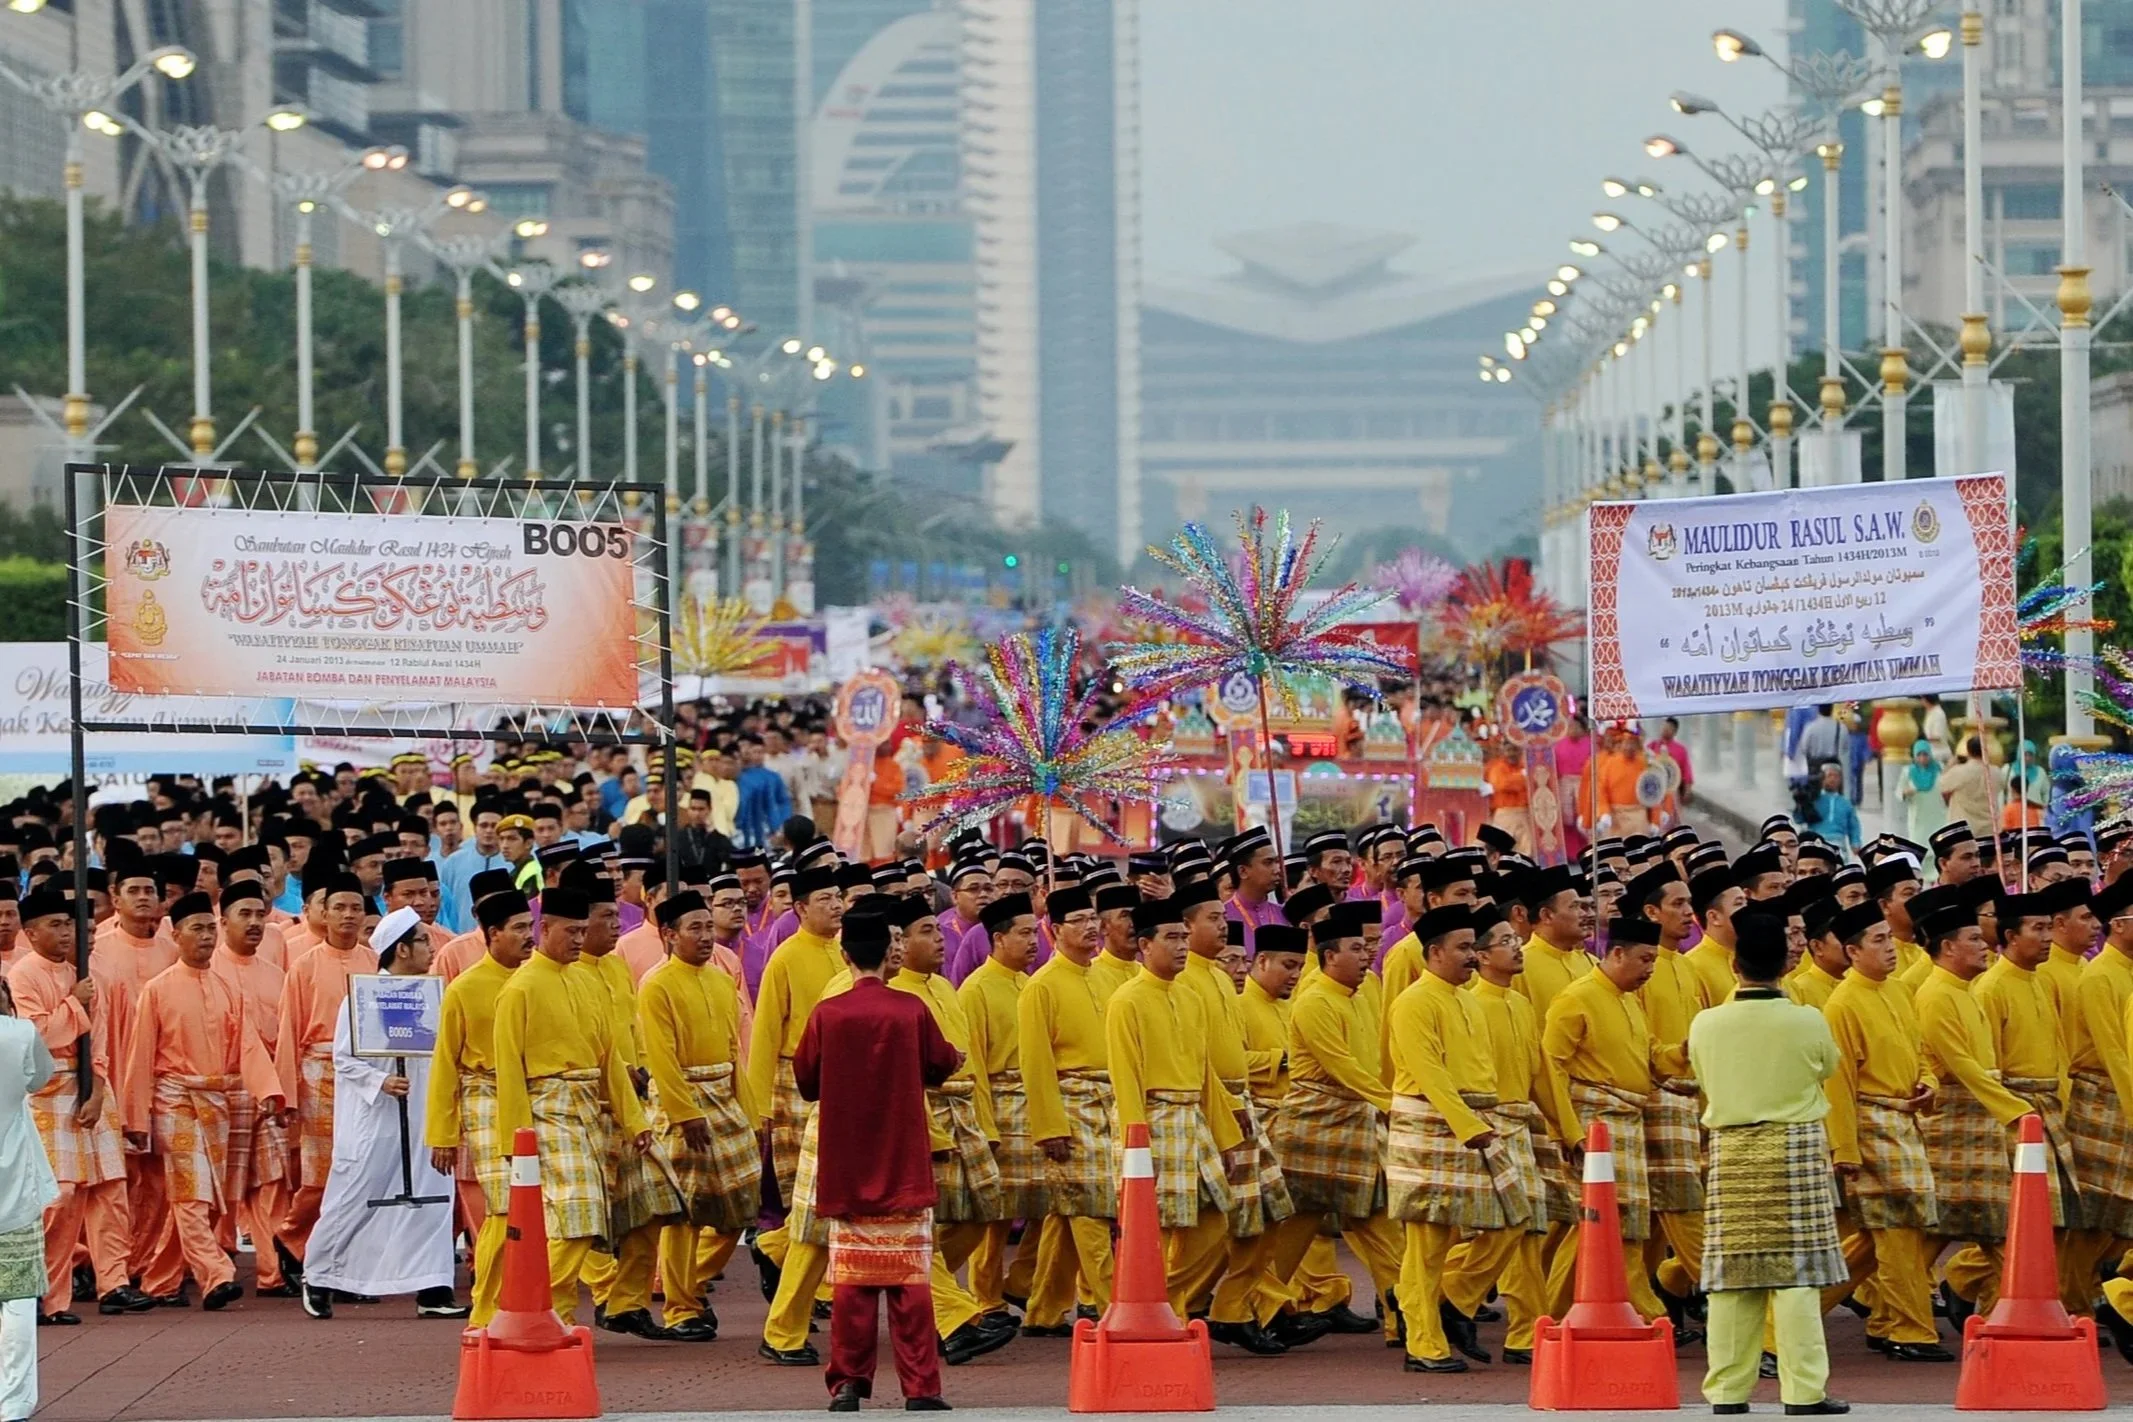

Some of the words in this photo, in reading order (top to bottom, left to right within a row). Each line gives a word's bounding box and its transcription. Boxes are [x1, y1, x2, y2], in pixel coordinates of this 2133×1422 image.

[1684, 521, 1781, 555] MAULIDUR
[1791, 517, 1846, 548] RASUL
[1854, 511, 1905, 542] S.A.W.
[234, 535, 306, 554] Sambutan
[310, 537, 376, 556] Maulidur
[379, 539, 422, 557] Rasul
[425, 541, 456, 558] 1434
[461, 542, 512, 565] Hijrah
[1686, 560, 1731, 575] Peringkat
[1735, 557, 1799, 572] Kebangsaan
[1802, 553, 1834, 565] Tahun
[1838, 547, 1907, 562] 1434H/2013M
[276, 655, 287, 663] 24
[289, 655, 321, 664] Januari
[323, 656, 344, 665] 2013
[390, 658, 400, 667] 12
[402, 658, 429, 667] Rabiul
[431, 659, 453, 668] Awal
[1662, 671, 1750, 698] WASATIYYAH
[1752, 667, 1819, 693] TONGGAK
[1820, 660, 1886, 688] KESATUAN
[1887, 654, 1942, 680] UMMAH
[256, 671, 304, 682] JABATAN
[306, 672, 345, 683] BOMBA
[348, 674, 372, 684] DAN
[375, 675, 441, 686] PENYELAMAT
[443, 677, 498, 688] MALAYSIA
